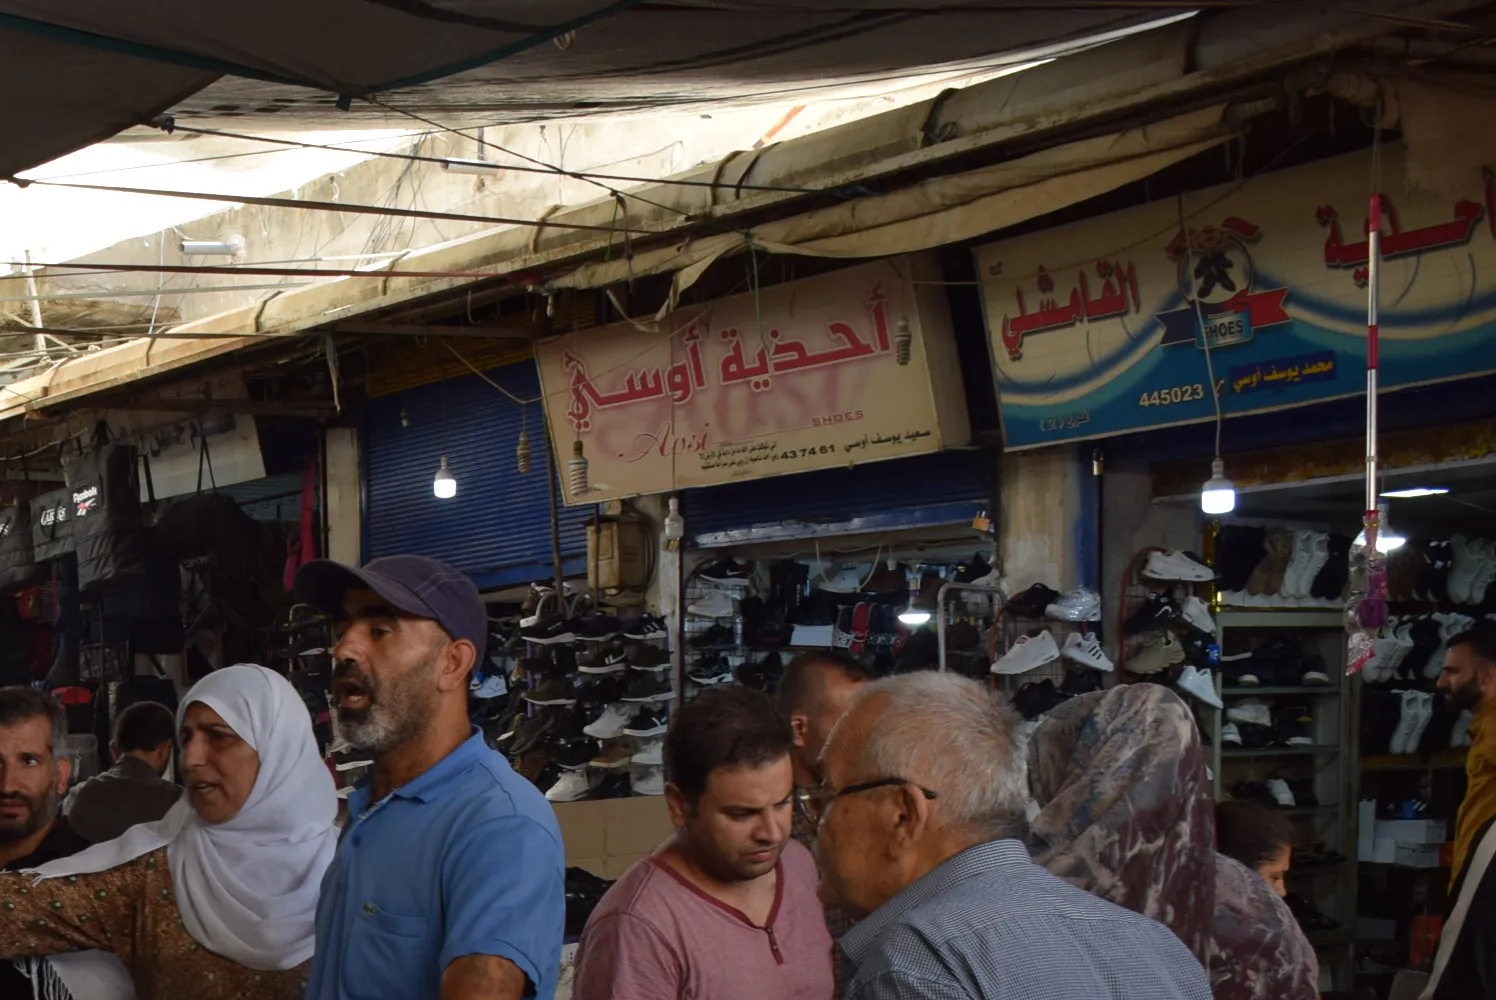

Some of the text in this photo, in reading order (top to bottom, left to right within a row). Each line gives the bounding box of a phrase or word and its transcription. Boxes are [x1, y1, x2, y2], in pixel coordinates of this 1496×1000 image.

[1204, 319, 1244, 339] SHOES
[564, 282, 892, 431] أحذية أوسي
[1264, 364, 1301, 381] يوسف
[1301, 359, 1334, 376] محمد
[1233, 366, 1262, 392] أوسي
[1138, 383, 1204, 407] 445023
[812, 410, 864, 427] SHOES
[844, 429, 931, 452] سعيد يوسف أوسي
[72, 486, 98, 503] Reebok
